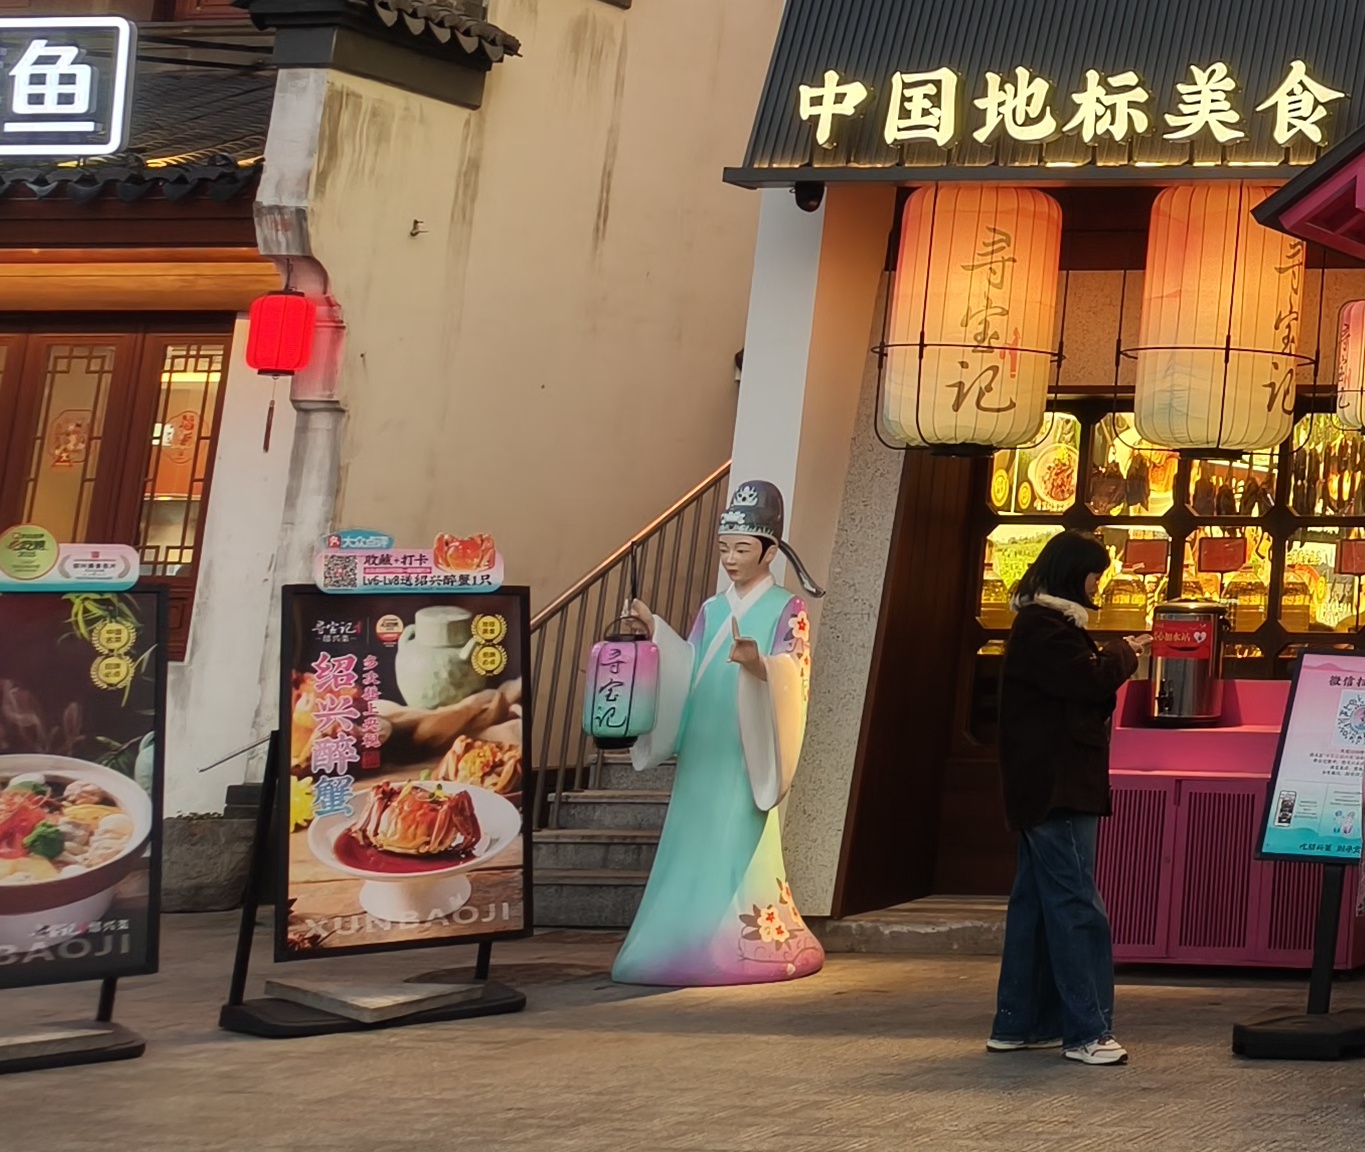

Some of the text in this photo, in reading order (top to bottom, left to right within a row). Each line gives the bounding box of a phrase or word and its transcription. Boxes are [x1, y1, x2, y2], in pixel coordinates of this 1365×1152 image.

[4, 39, 94, 132] 鱼
[799, 61, 1344, 147] 中国地标美食
[946, 226, 1017, 413] 寻宝记
[363, 554, 428, 565] 收藏+打卡
[595, 648, 627, 728] 寻宝记
[311, 651, 359, 817] 绍兴醉蟹
[305, 902, 510, 938] XUNBAOJI
